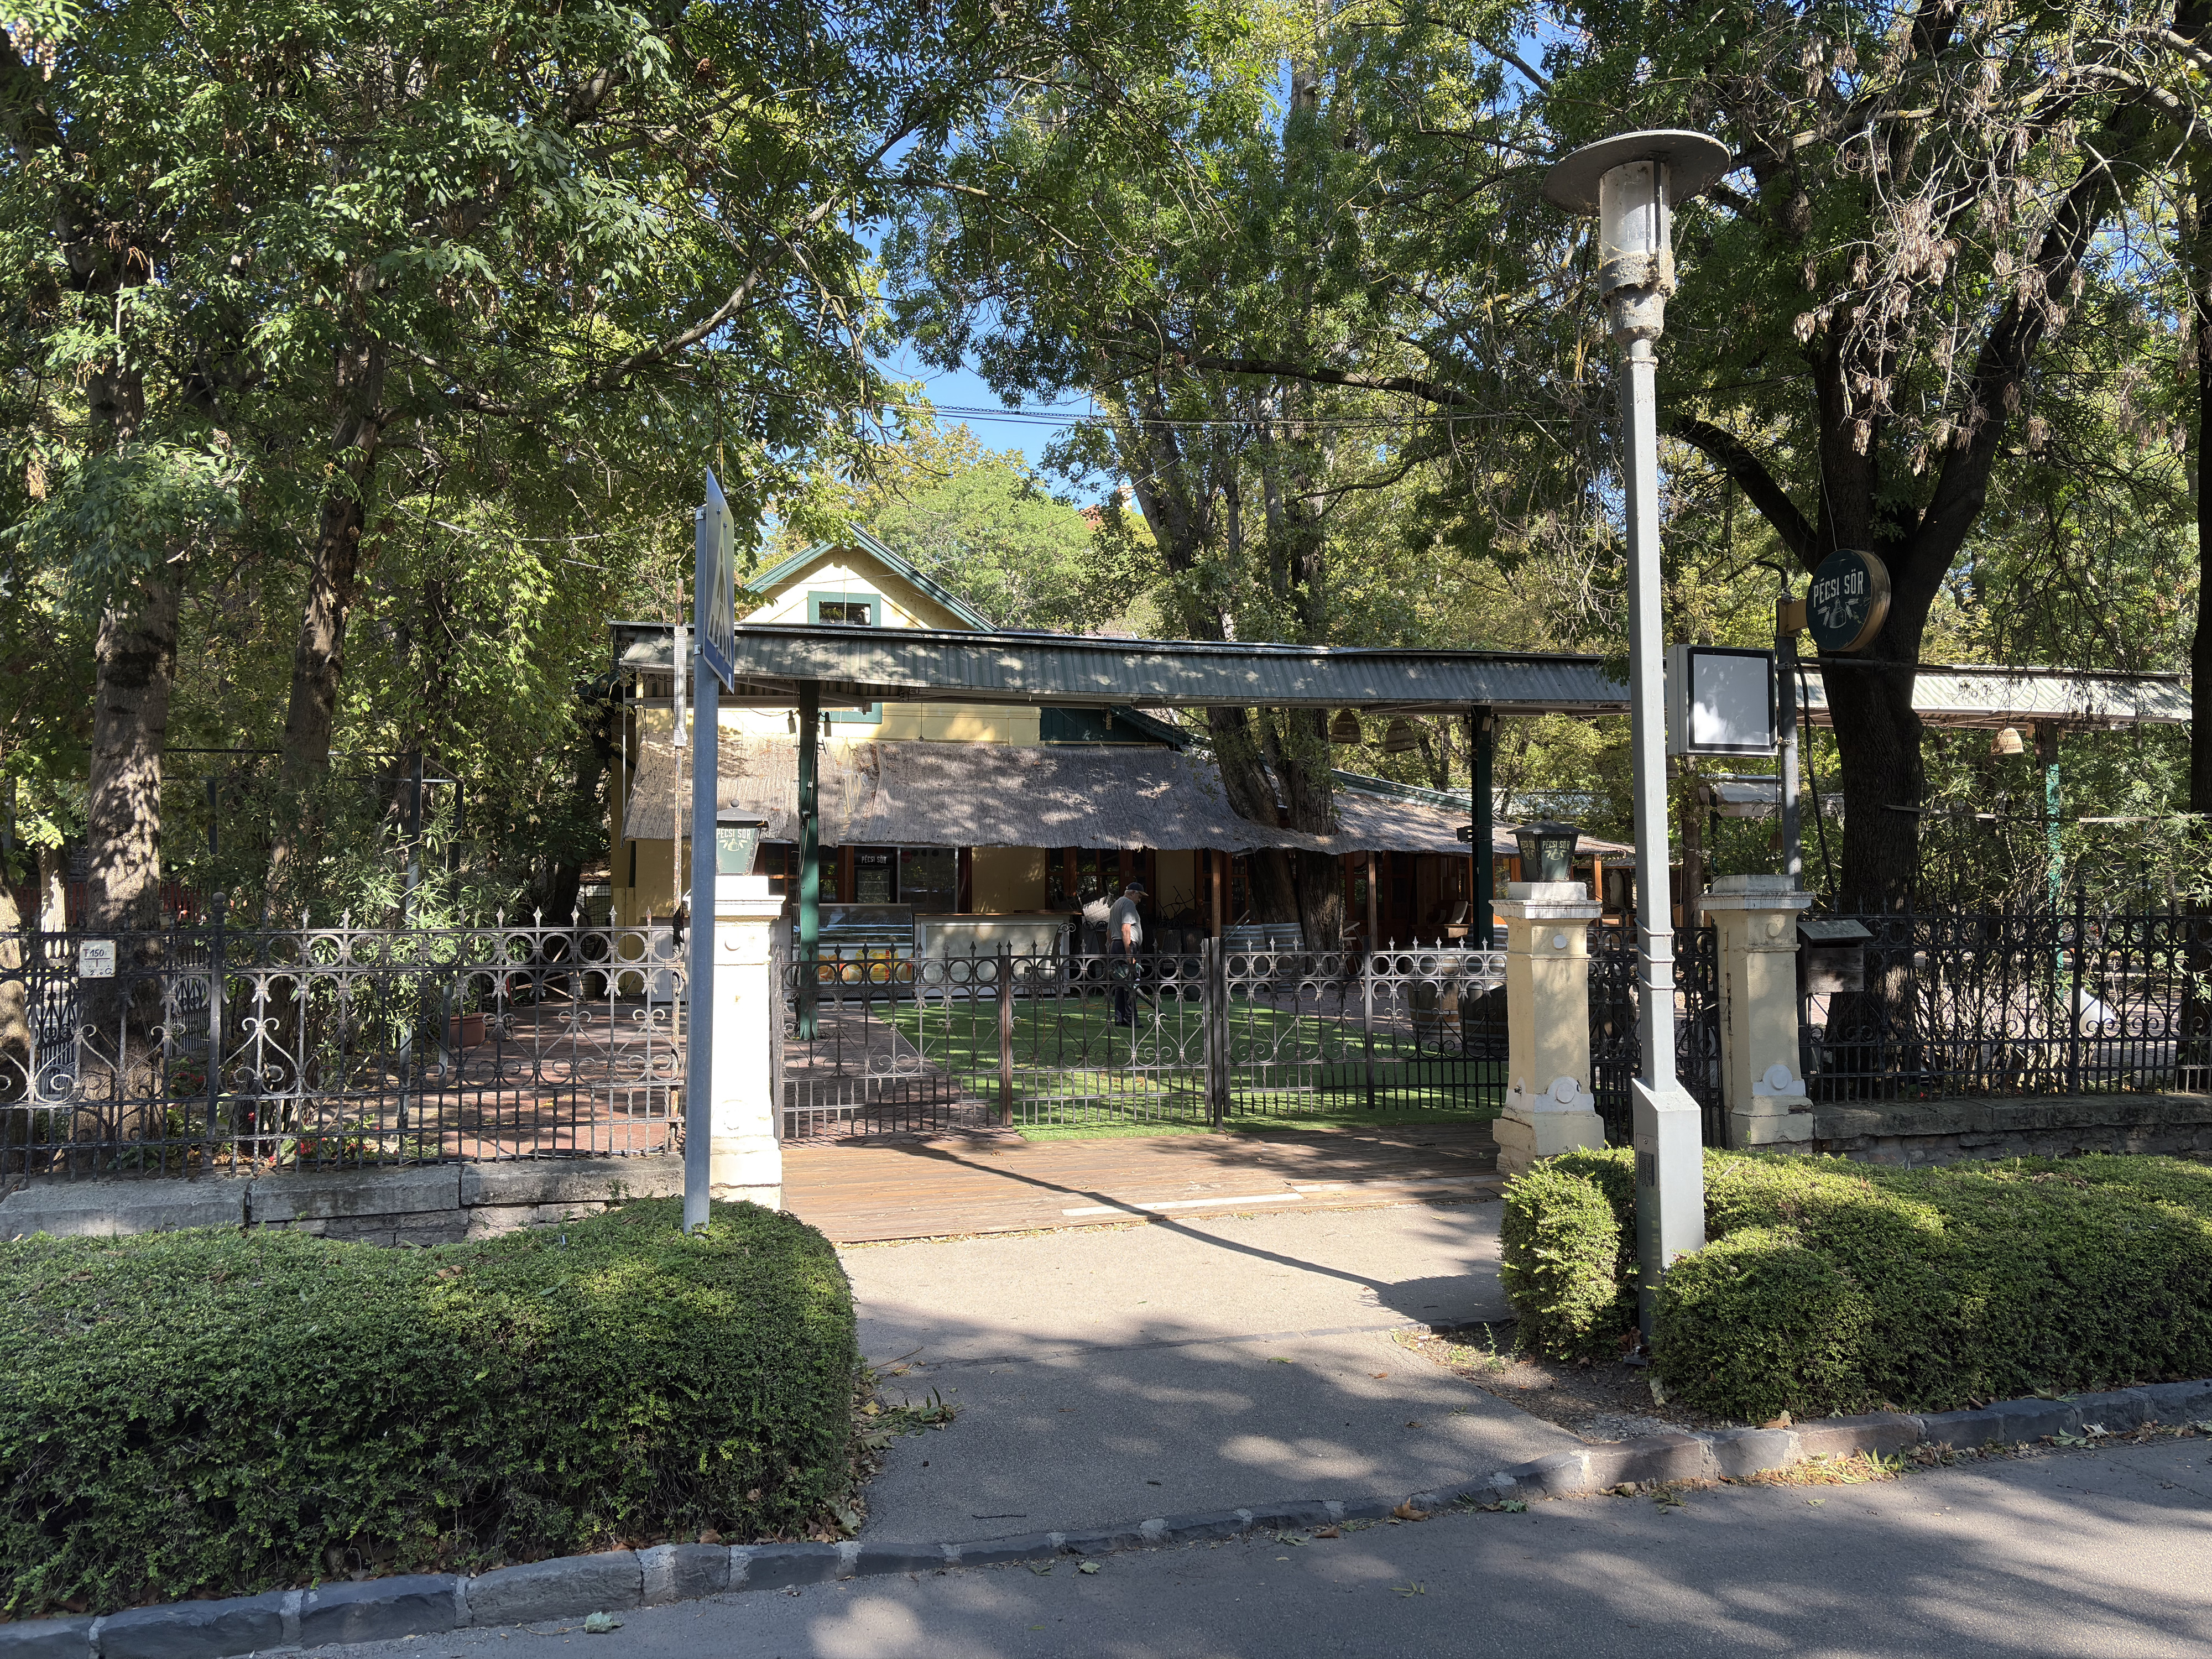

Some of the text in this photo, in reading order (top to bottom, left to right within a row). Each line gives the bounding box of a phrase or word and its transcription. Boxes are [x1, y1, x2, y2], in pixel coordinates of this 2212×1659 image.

[1813, 568, 1864, 608] PÉCSI SÖR
[716, 827, 751, 840] PÉCSI SÖR
[1542, 838, 1571, 850] PÉCSI SÖR
[862, 854, 887, 864] PÉCSI SÖR
[90, 949, 105, 957] 150
